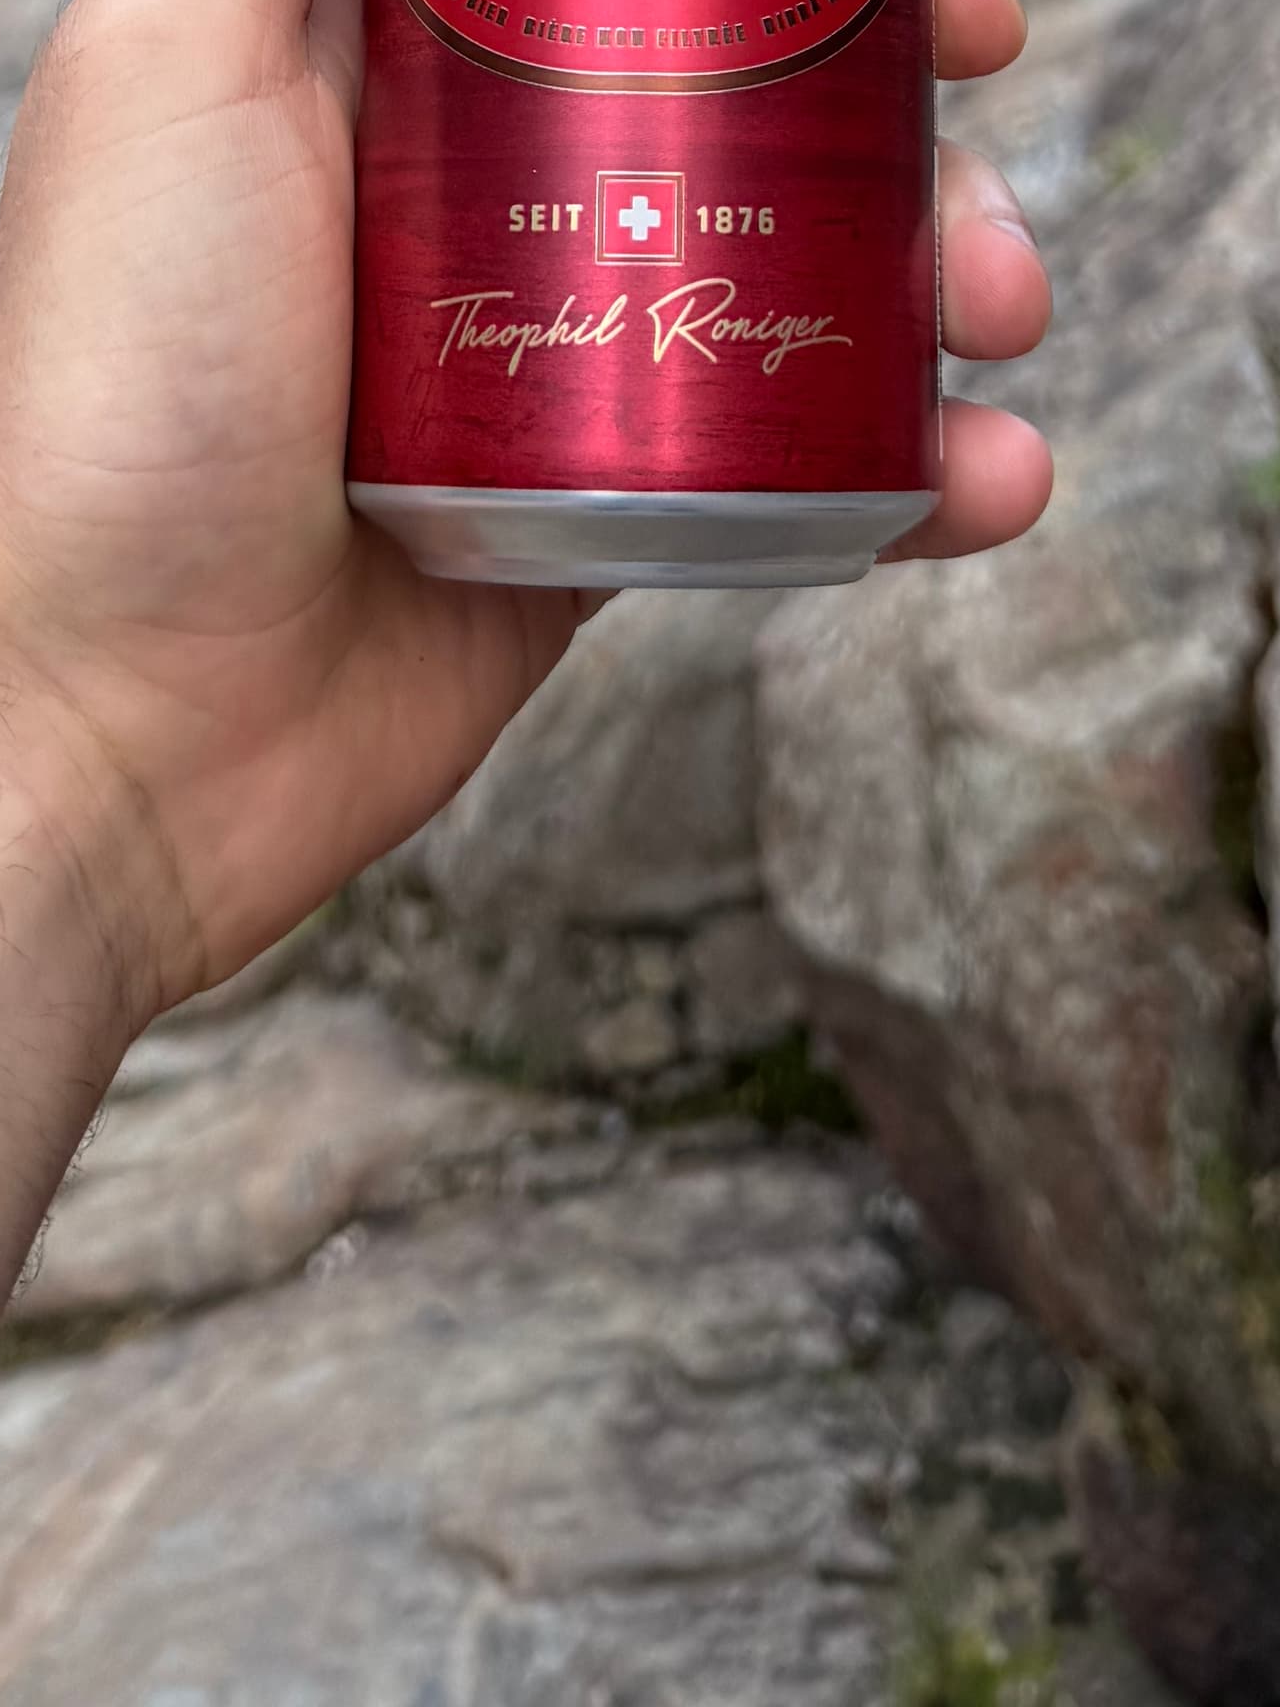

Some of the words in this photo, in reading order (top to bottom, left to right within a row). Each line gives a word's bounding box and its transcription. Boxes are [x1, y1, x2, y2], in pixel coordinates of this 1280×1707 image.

[522, 15, 587, 46] BIÈRE
[596, 26, 646, 49] NON
[655, 20, 747, 49] FILTRÉE
[508, 203, 584, 233] SEIT
[696, 205, 776, 235] 1876
[430, 290, 628, 378] Theophil
[645, 277, 854, 375] Roniger
